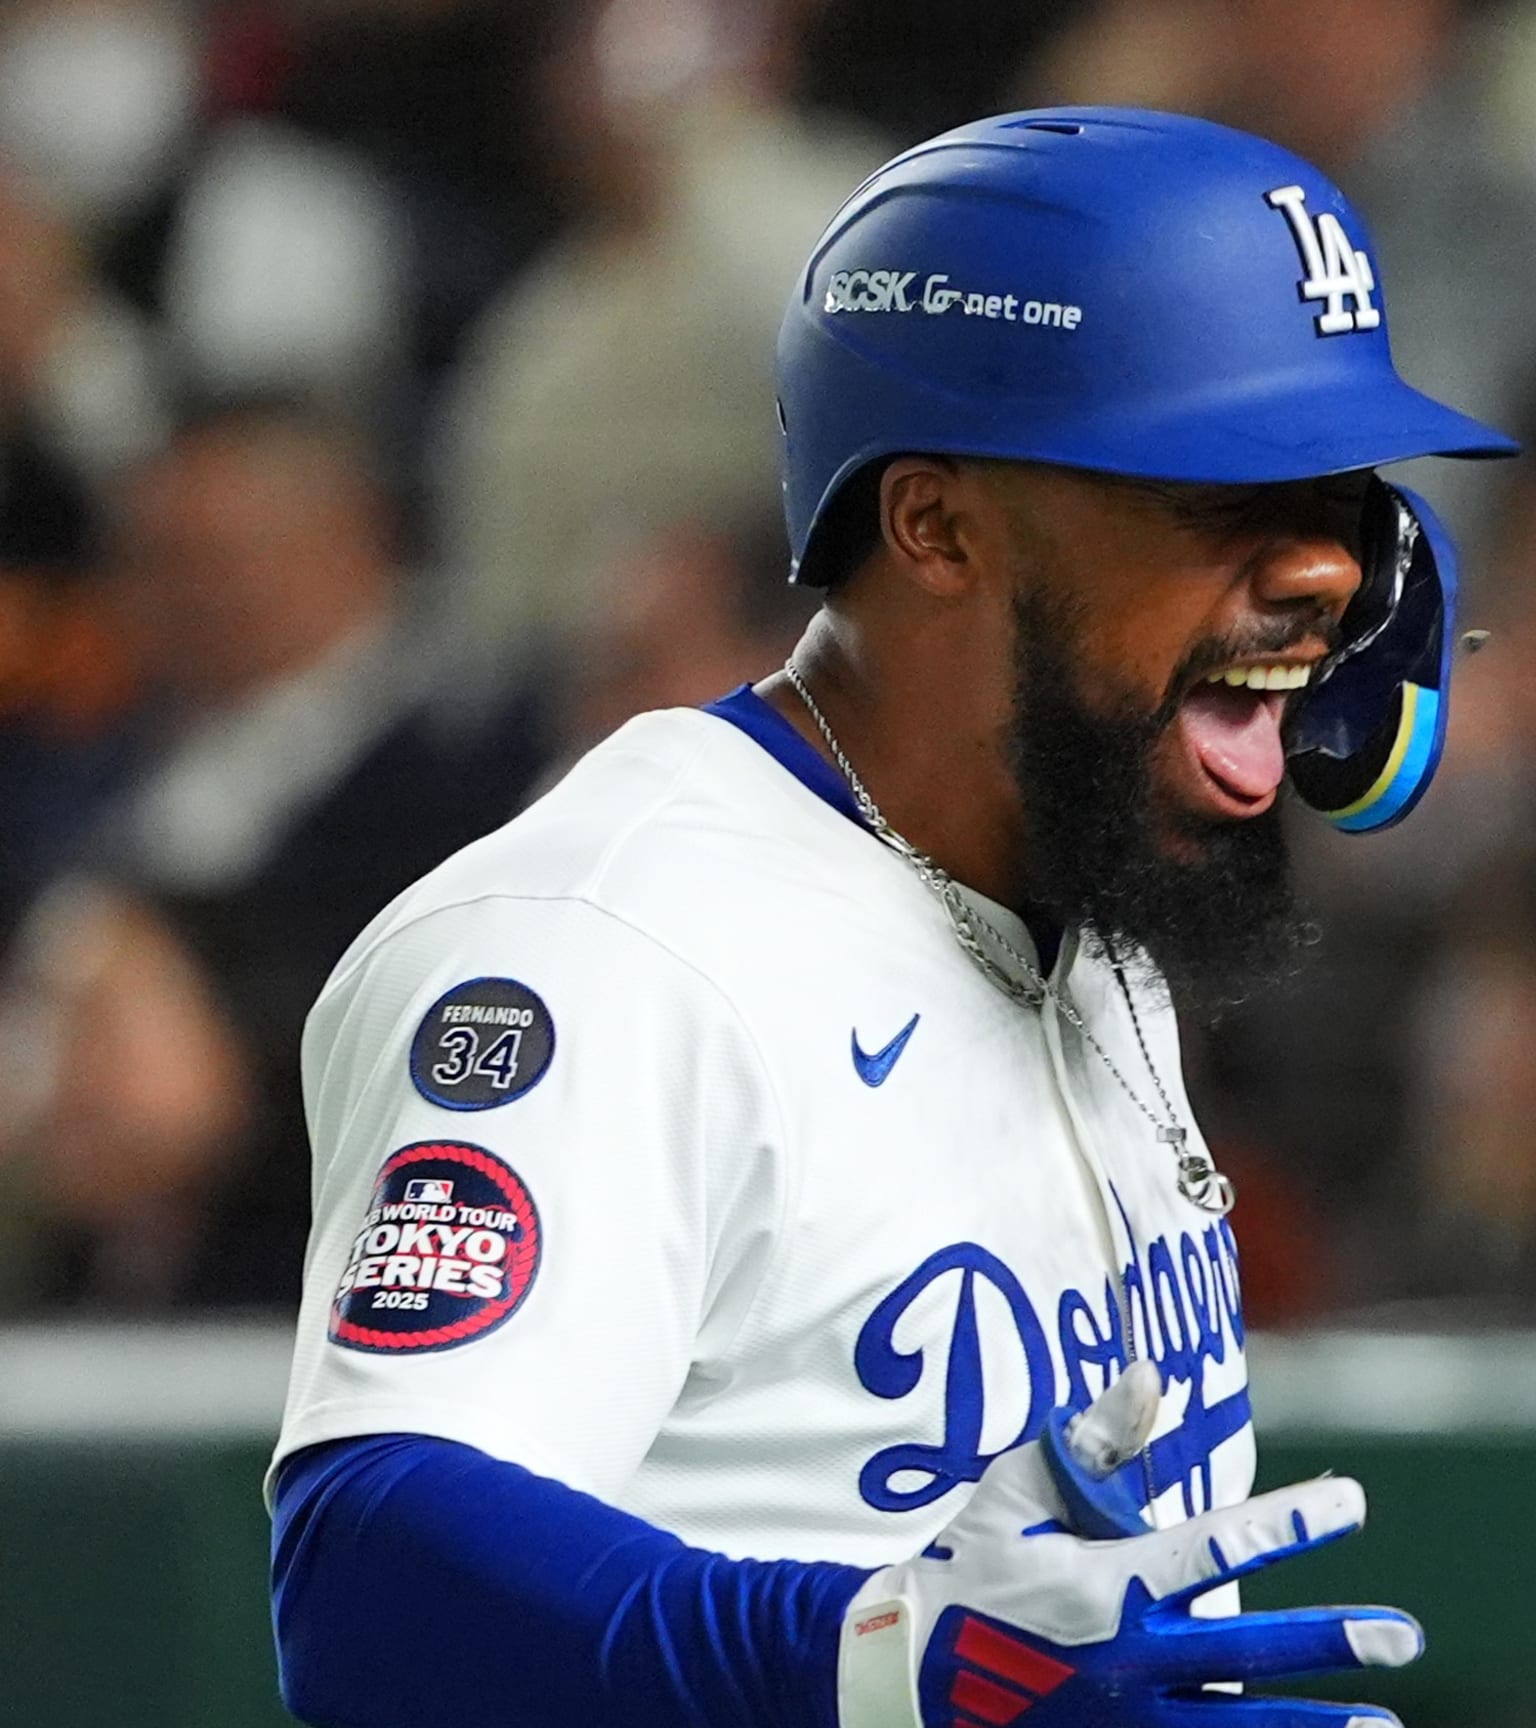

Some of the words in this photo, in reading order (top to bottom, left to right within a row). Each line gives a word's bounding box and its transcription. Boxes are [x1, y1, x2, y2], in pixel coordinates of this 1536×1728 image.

[1264, 184, 1380, 335] LA
[966, 292, 1017, 321] net
[1023, 299, 1082, 330] one
[441, 1004, 534, 1028] FERNANDO
[433, 1028, 522, 1088] 34
[382, 1203, 457, 1223] WORLD
[459, 1206, 518, 1232] TOUR
[351, 1223, 506, 1263] TOKYO
[371, 1291, 430, 1311] 2025
